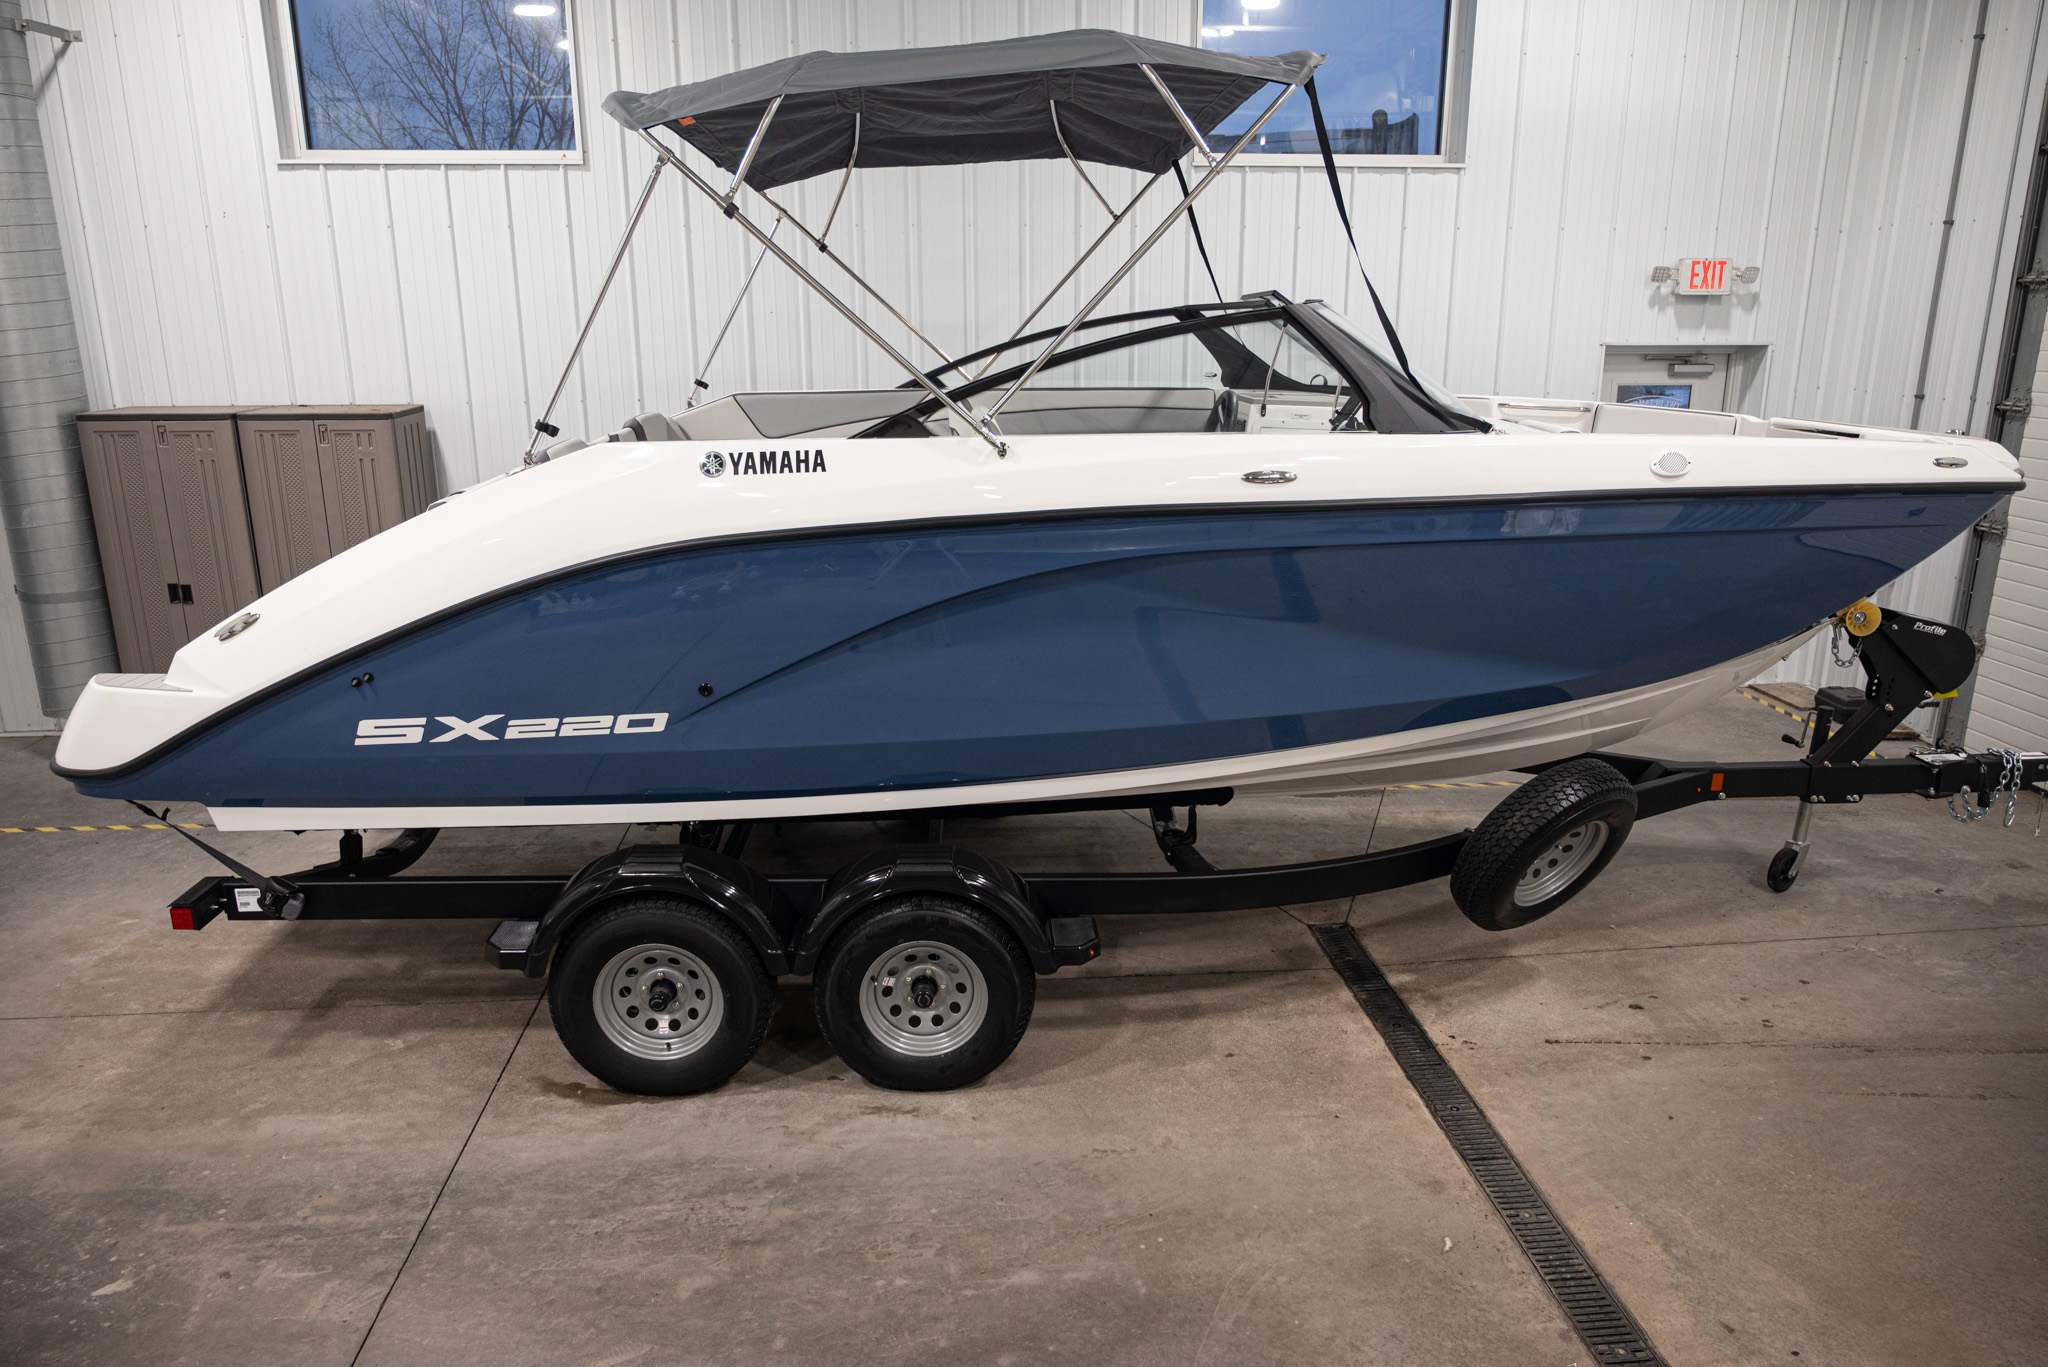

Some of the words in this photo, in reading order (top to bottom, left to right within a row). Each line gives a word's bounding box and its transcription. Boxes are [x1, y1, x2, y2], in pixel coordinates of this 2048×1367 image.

[1689, 260, 1727, 290] EXIT
[728, 449, 827, 476] YAMAHA
[1913, 621, 1947, 635] Profile
[354, 712, 670, 746] SX220
